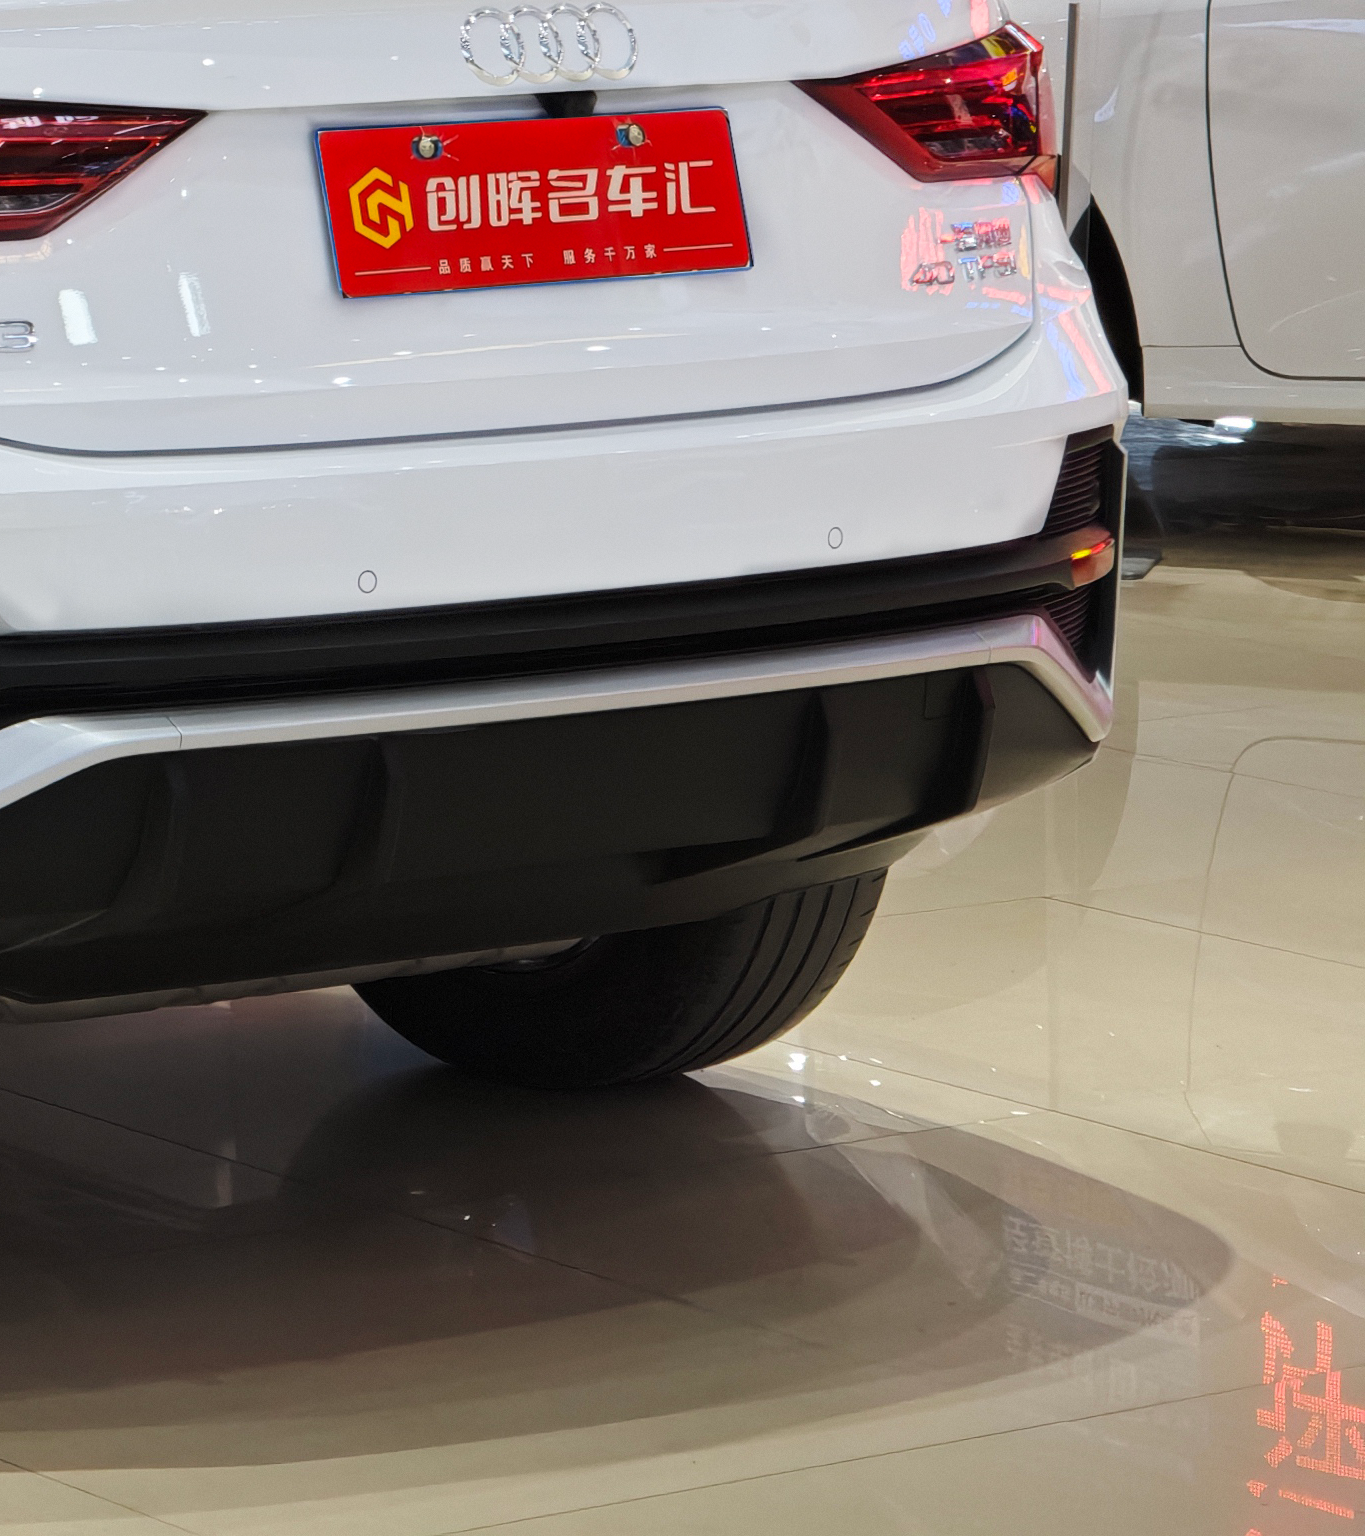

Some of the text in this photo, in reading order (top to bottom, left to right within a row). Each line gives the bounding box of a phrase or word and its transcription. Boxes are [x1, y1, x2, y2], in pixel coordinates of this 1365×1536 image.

[425, 159, 717, 233] 创晖名车汇
[438, 242, 658, 275] 品质赢天下 服务千万家
